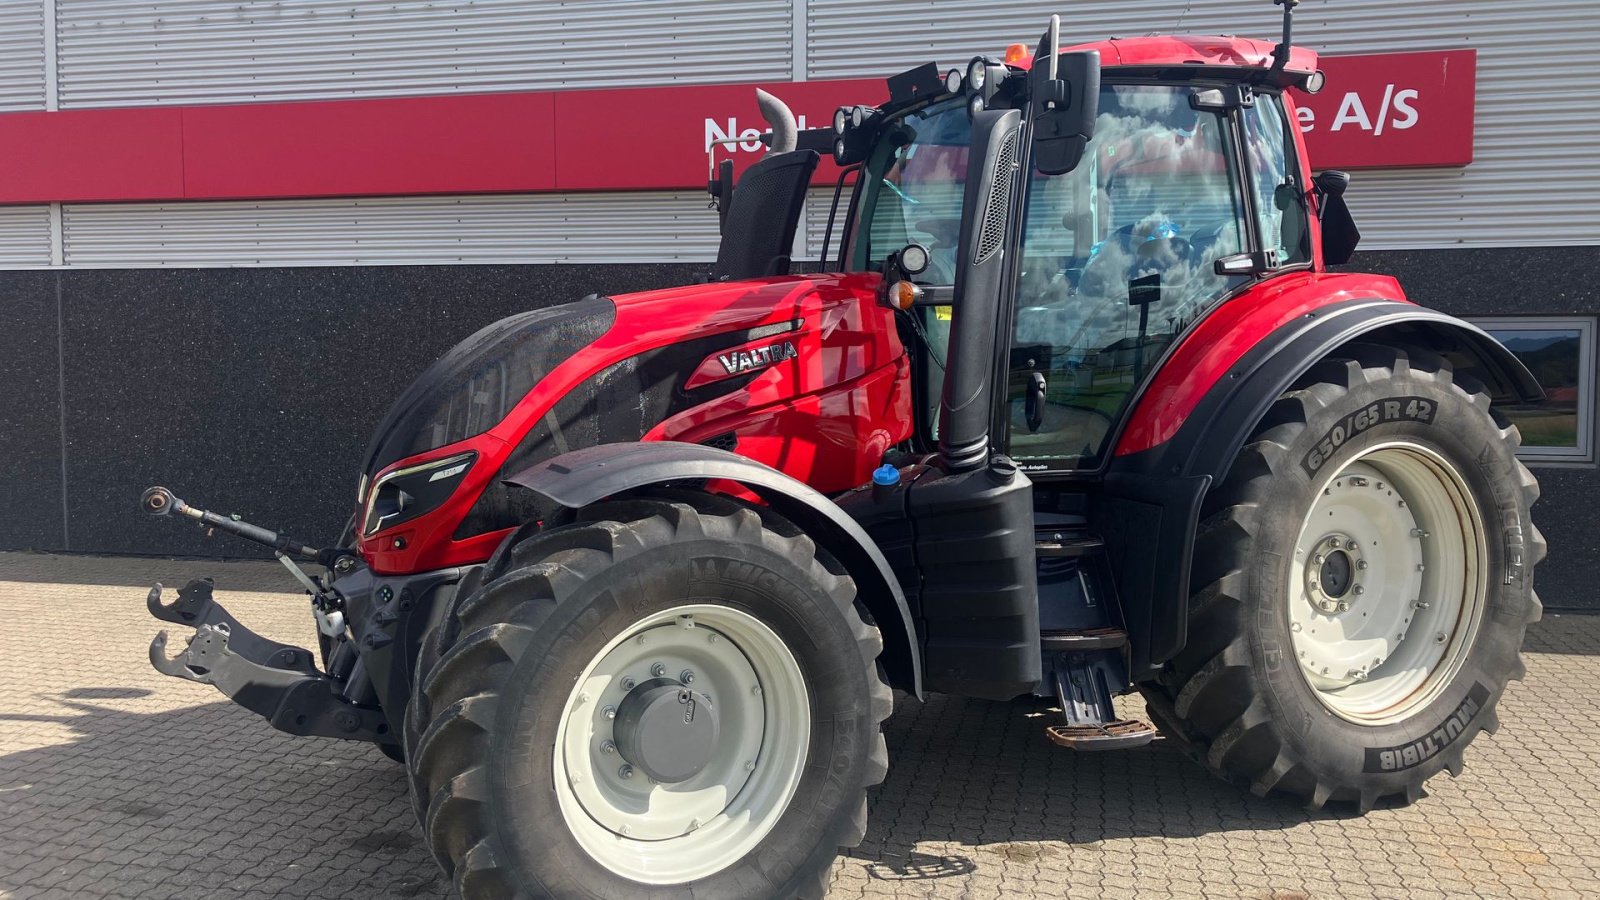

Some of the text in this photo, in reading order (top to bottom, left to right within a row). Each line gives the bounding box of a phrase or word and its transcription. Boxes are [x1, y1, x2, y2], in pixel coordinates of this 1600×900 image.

[1330, 84, 1419, 136] A/S
[719, 341, 797, 374] VALTRA
[1308, 400, 1432, 470] 650/65 R 42
[1380, 697, 1479, 770] MULTIBIB
